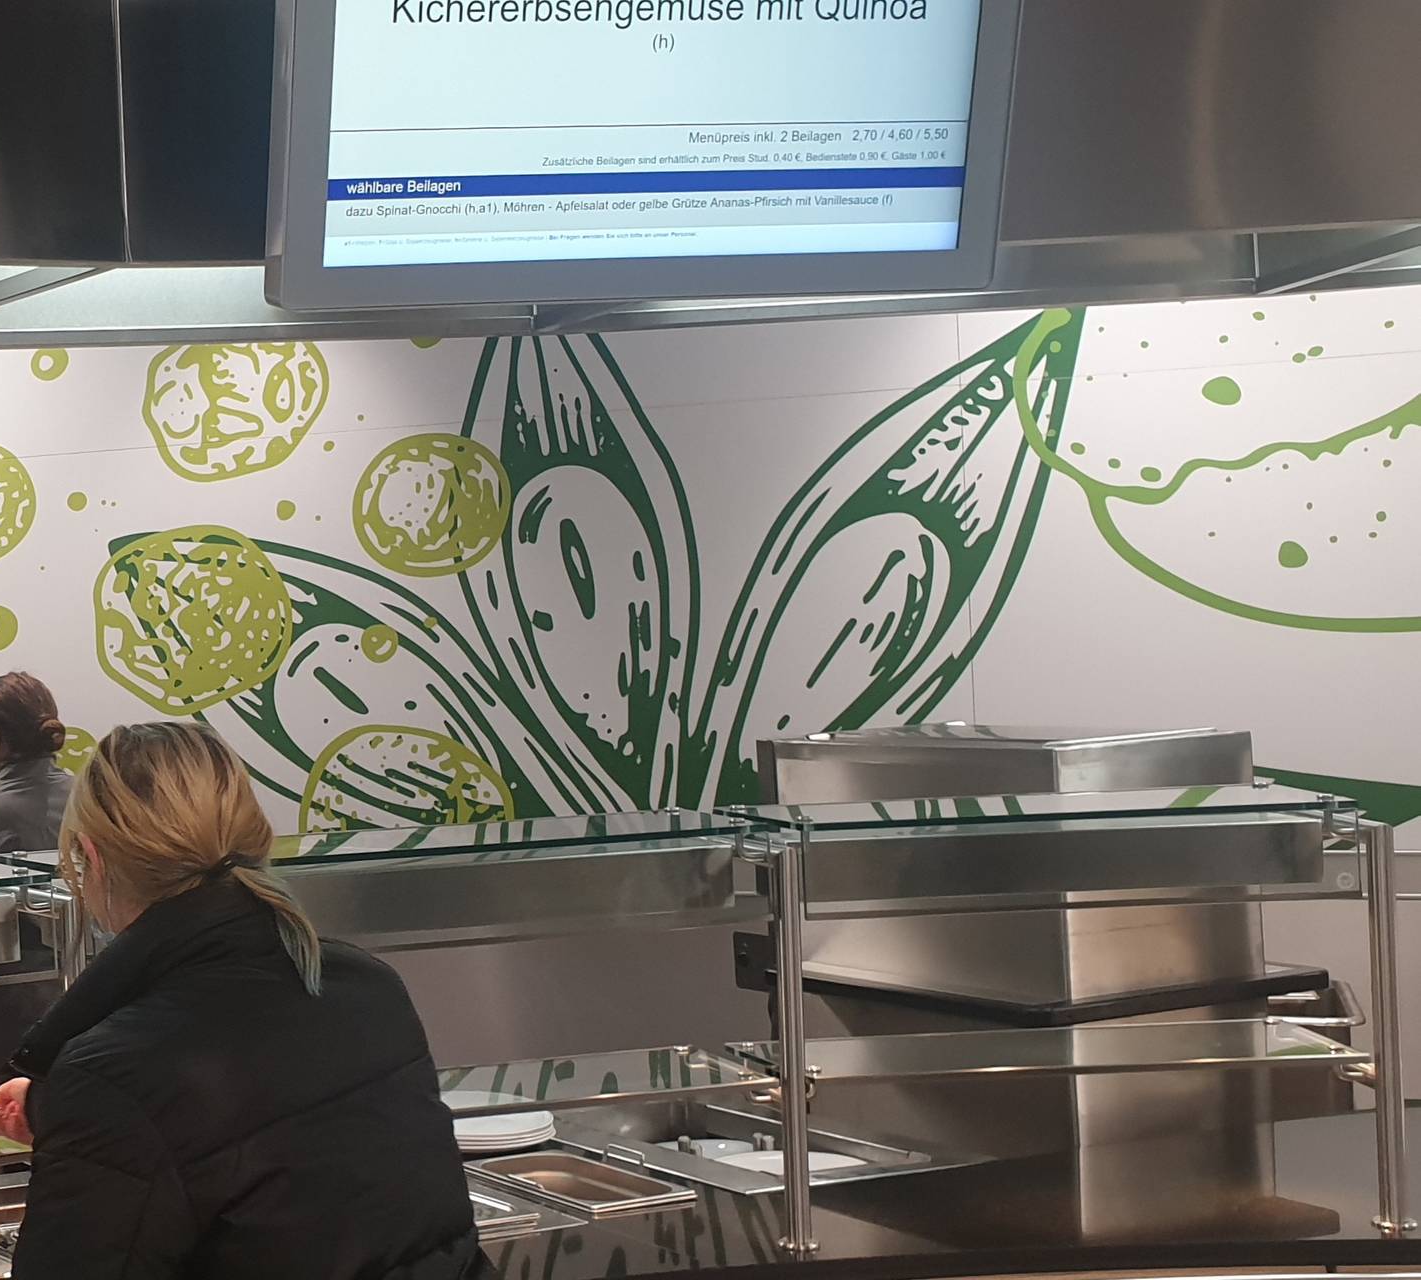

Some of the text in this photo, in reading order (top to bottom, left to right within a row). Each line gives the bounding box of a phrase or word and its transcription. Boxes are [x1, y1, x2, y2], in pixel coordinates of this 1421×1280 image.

[757, 0, 803, 20] mit
[815, 0, 926, 21] Quinoa
[652, 34, 675, 52] (h)
[688, 131, 750, 145] Menüpreis
[753, 131, 776, 143] inkl.
[780, 130, 788, 142] 2
[791, 130, 842, 144] Beilagen
[852, 129, 878, 142] 2,70
[888, 129, 913, 141] 4,60
[924, 128, 949, 141] 5,50
[542, 156, 594, 167] Zusätzliche
[596, 156, 636, 167] Beilagen
[638, 155, 657, 165] sind
[659, 154, 699, 164] erhältlich
[701, 156, 721, 164] zum
[723, 154, 746, 163] Preis
[806, 152, 857, 162] Bedienstete
[891, 151, 917, 161] Gäste
[346, 180, 461, 195] wählbare Beilagen
[345, 206, 373, 217] dazu
[376, 204, 461, 218] Spinat-Gnocchi
[503, 202, 545, 213] Möhren
[555, 200, 609, 213] Apfelsalat
[612, 200, 635, 210] oder
[639, 199, 668, 212] gelbe
[672, 198, 707, 209] Grütze
[710, 196, 793, 209] Ananas-Pfirsich
[795, 196, 811, 207] mit
[814, 195, 879, 207] Vanillesauce
[882, 194, 893, 206] (f)
